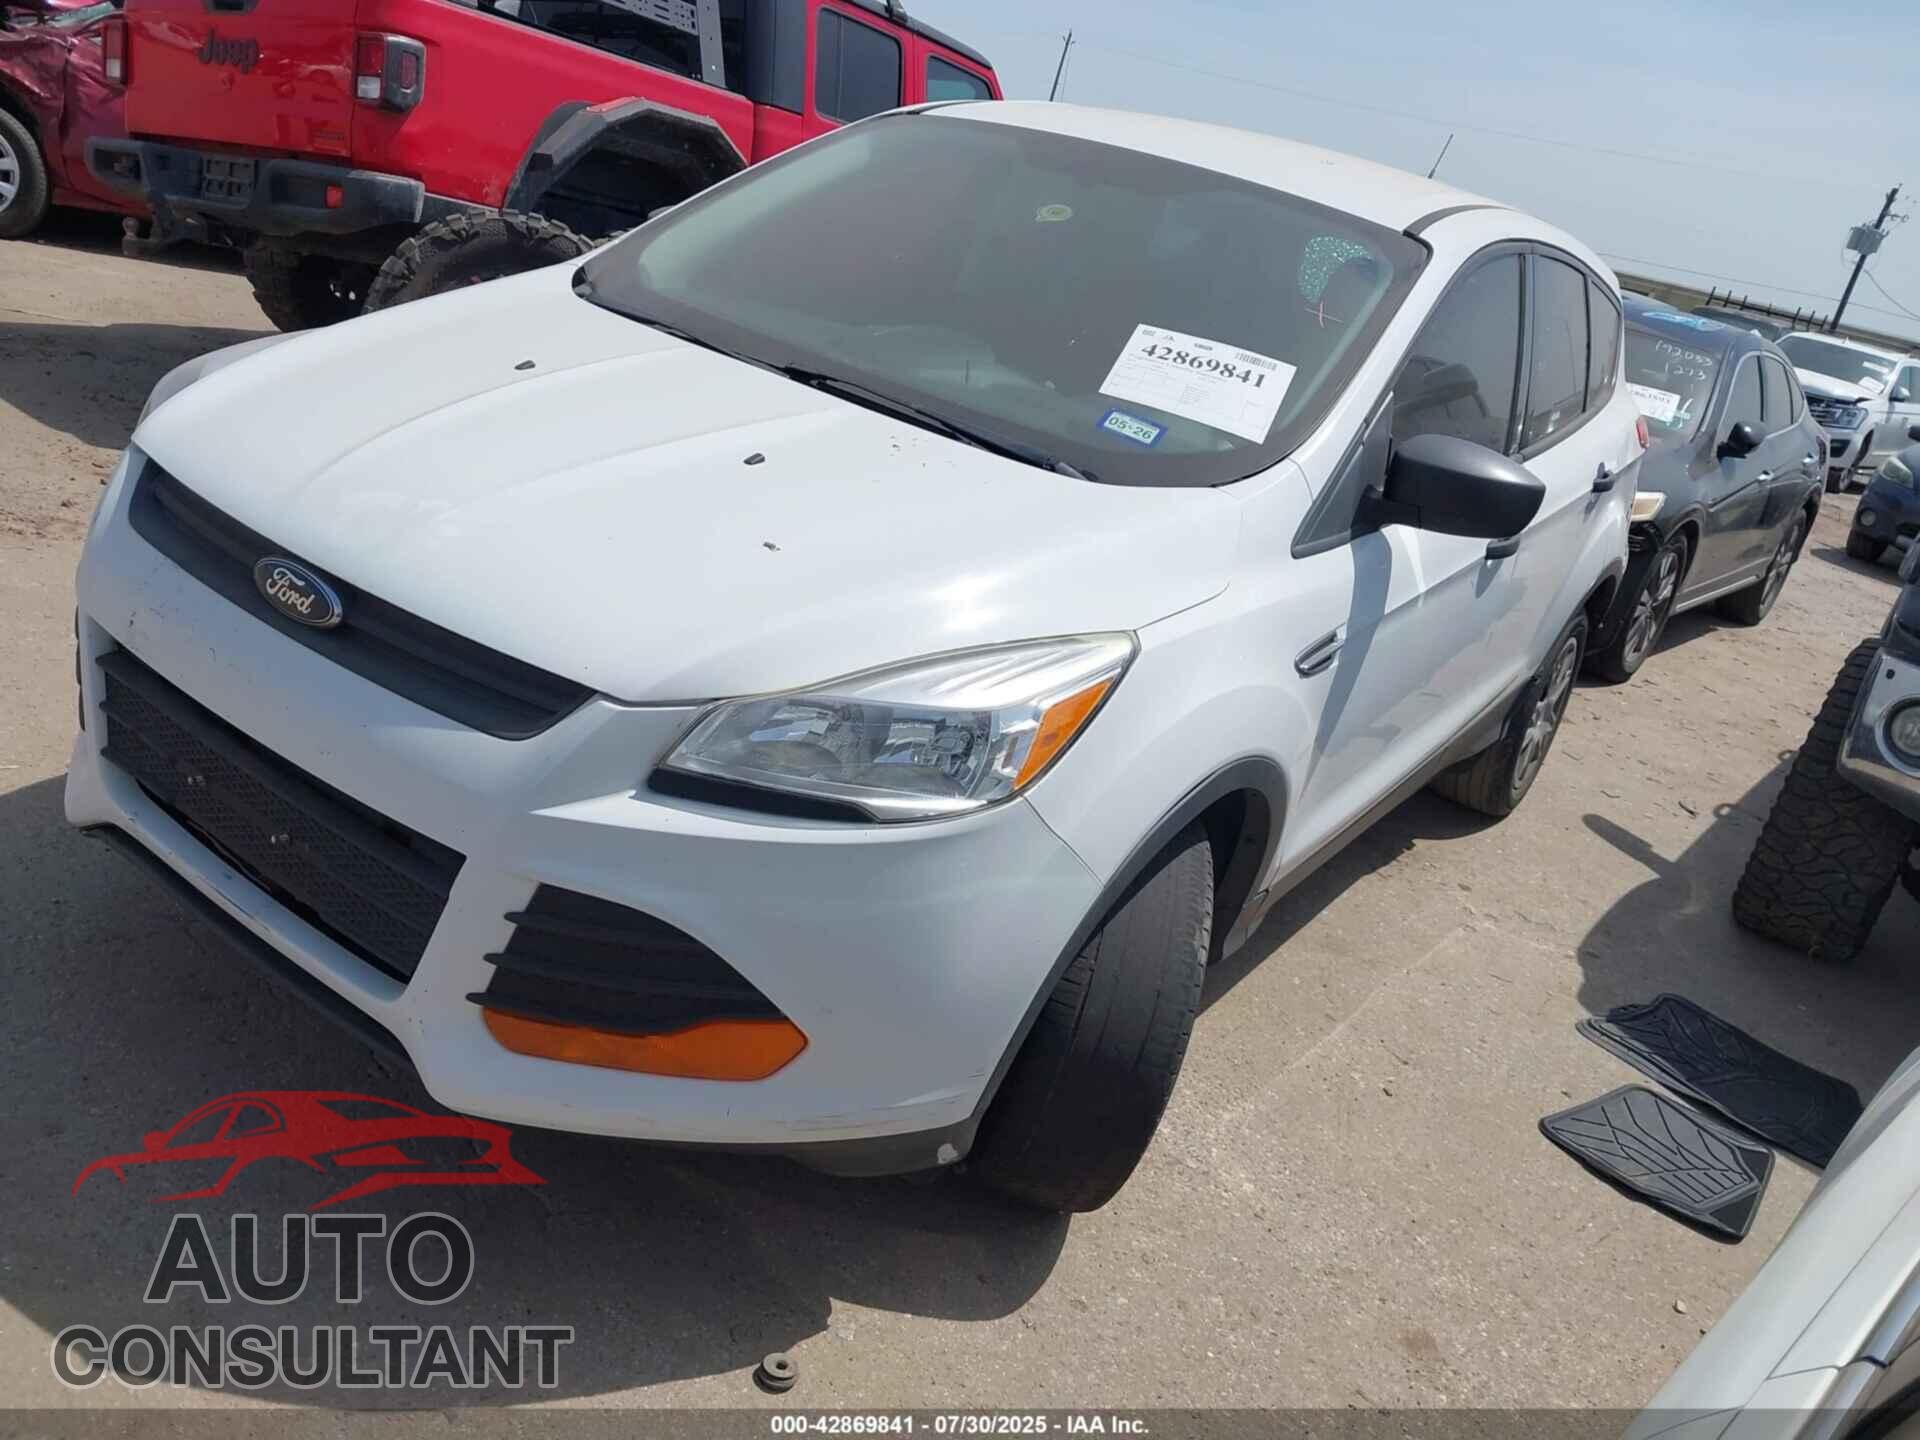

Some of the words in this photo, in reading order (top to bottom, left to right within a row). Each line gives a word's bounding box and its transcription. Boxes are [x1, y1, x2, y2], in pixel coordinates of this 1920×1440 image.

[198, 28, 258, 74] Jeep
[1141, 343, 1267, 389] 42869841
[265, 567, 316, 615] Ford
